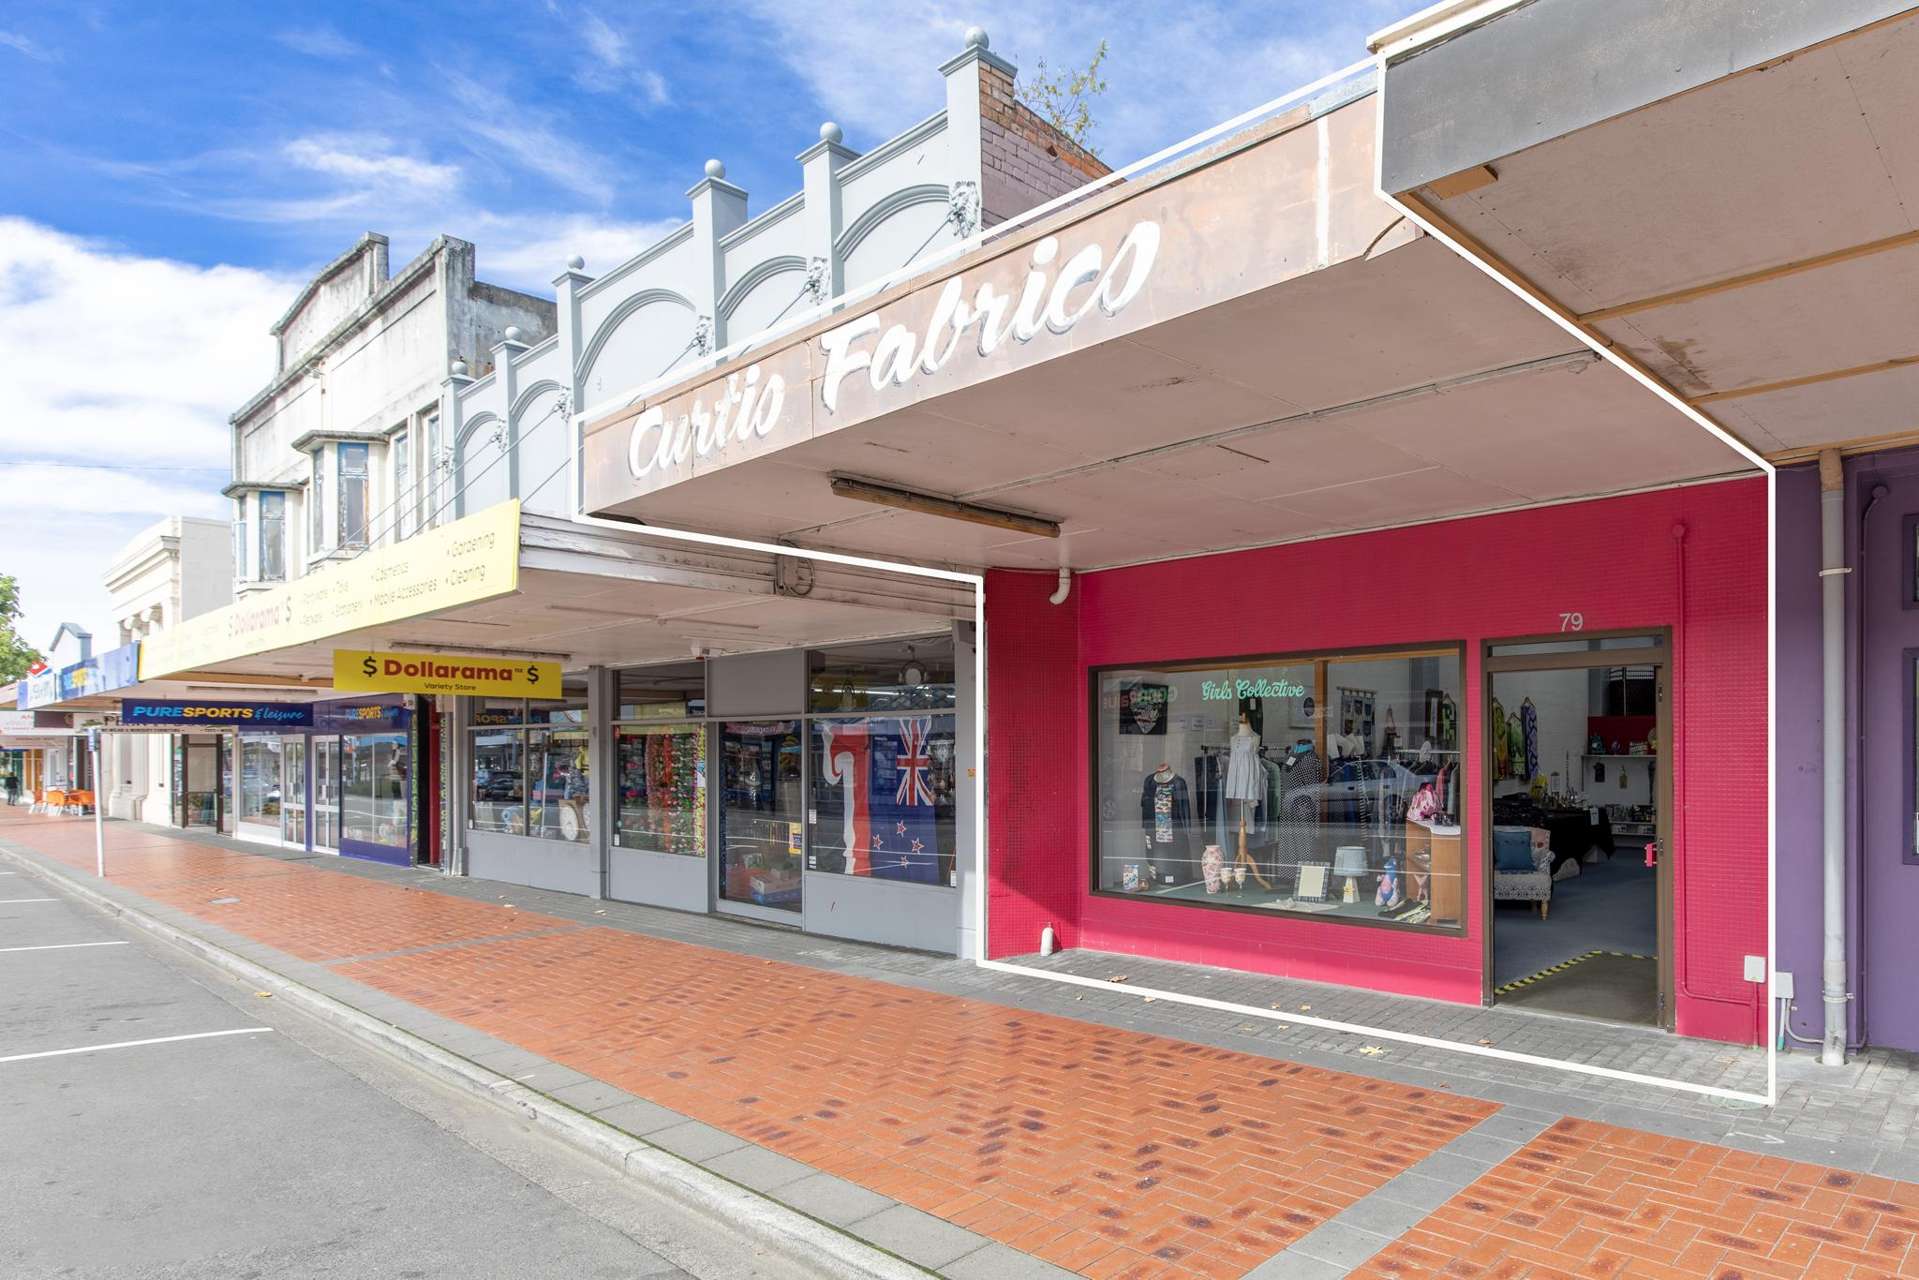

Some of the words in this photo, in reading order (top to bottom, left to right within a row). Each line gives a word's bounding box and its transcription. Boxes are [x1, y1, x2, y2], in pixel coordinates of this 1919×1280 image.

[629, 364, 785, 479] Curtio
[820, 220, 1161, 415] Fabrico
[1559, 612, 1584, 632] 79
[363, 656, 377, 677] $
[384, 659, 513, 681] Dollarama
[527, 665, 539, 684] $
[424, 682, 453, 691] Variety
[455, 682, 476, 691] Store
[1202, 680, 1233, 701] Girls
[1235, 679, 1305, 699] Collective
